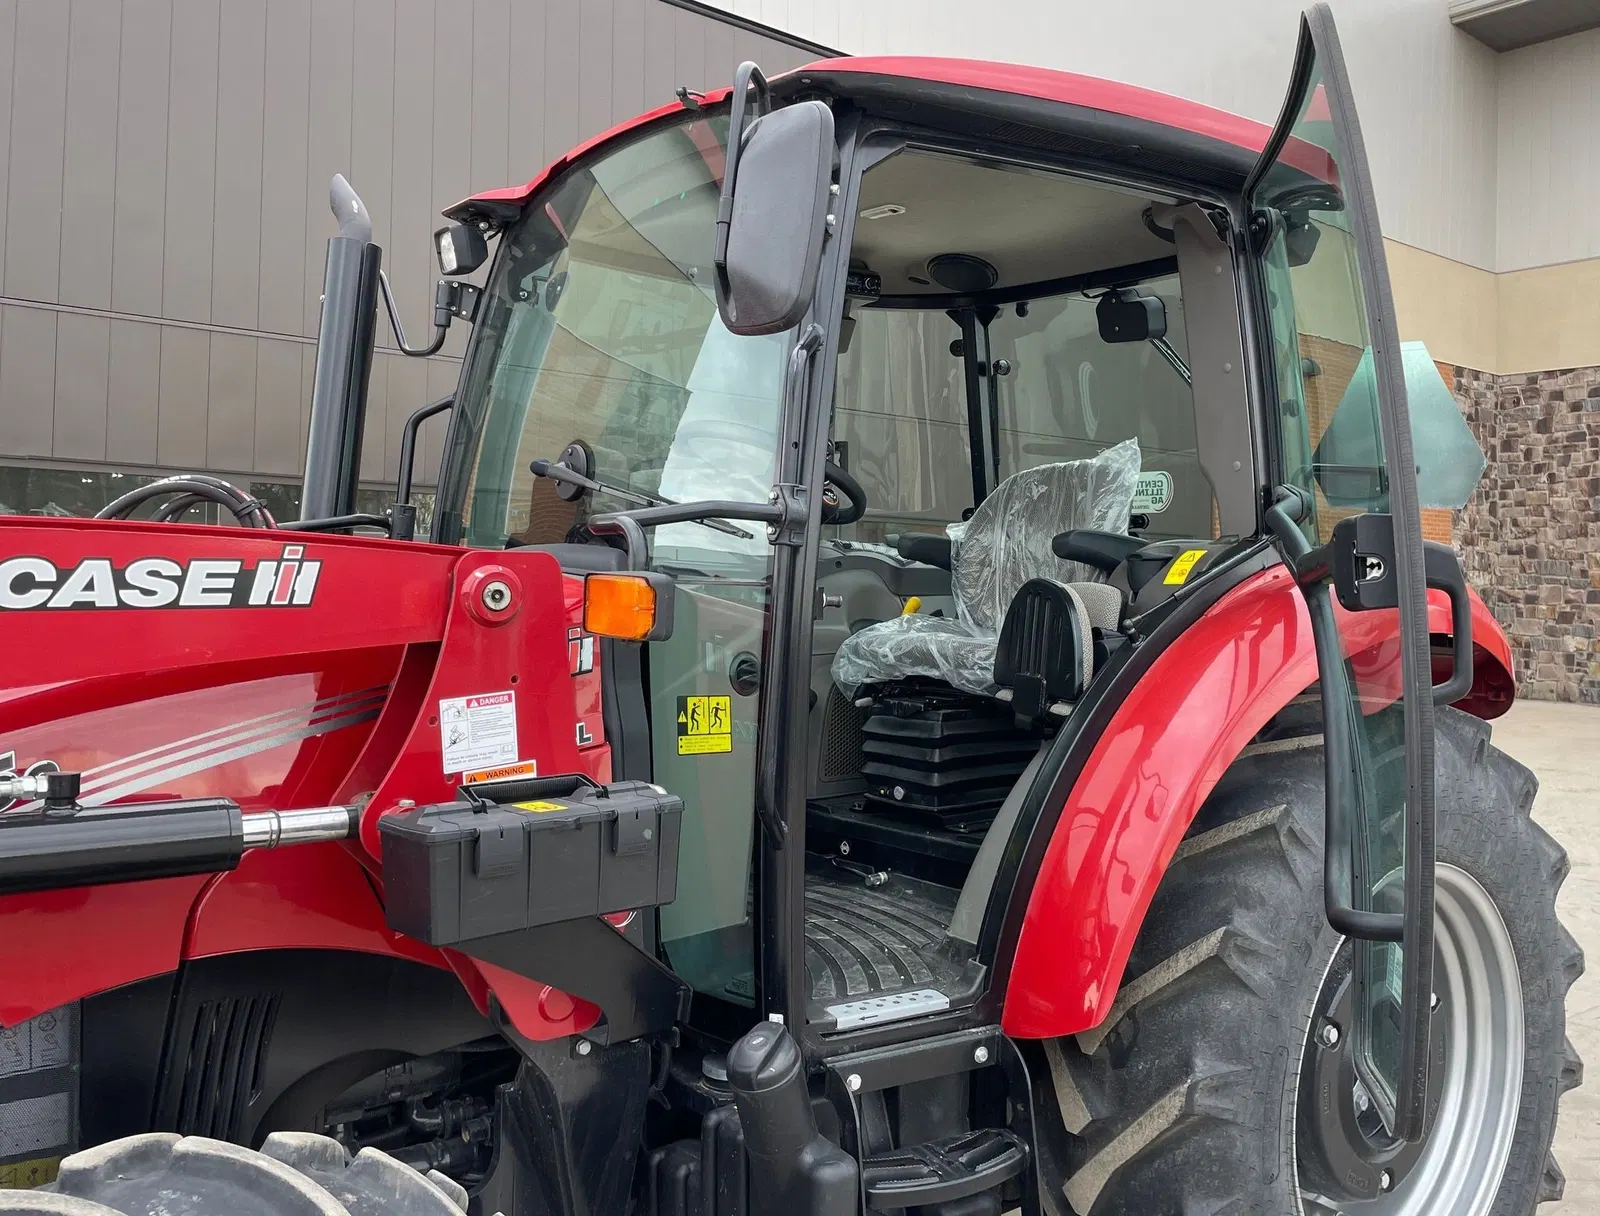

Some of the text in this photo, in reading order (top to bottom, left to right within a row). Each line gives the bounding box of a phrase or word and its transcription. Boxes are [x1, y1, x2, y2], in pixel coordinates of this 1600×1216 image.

[0, 558, 242, 608] CASE
[479, 694, 509, 706] DANGER
[485, 766, 524, 779] WARNING
